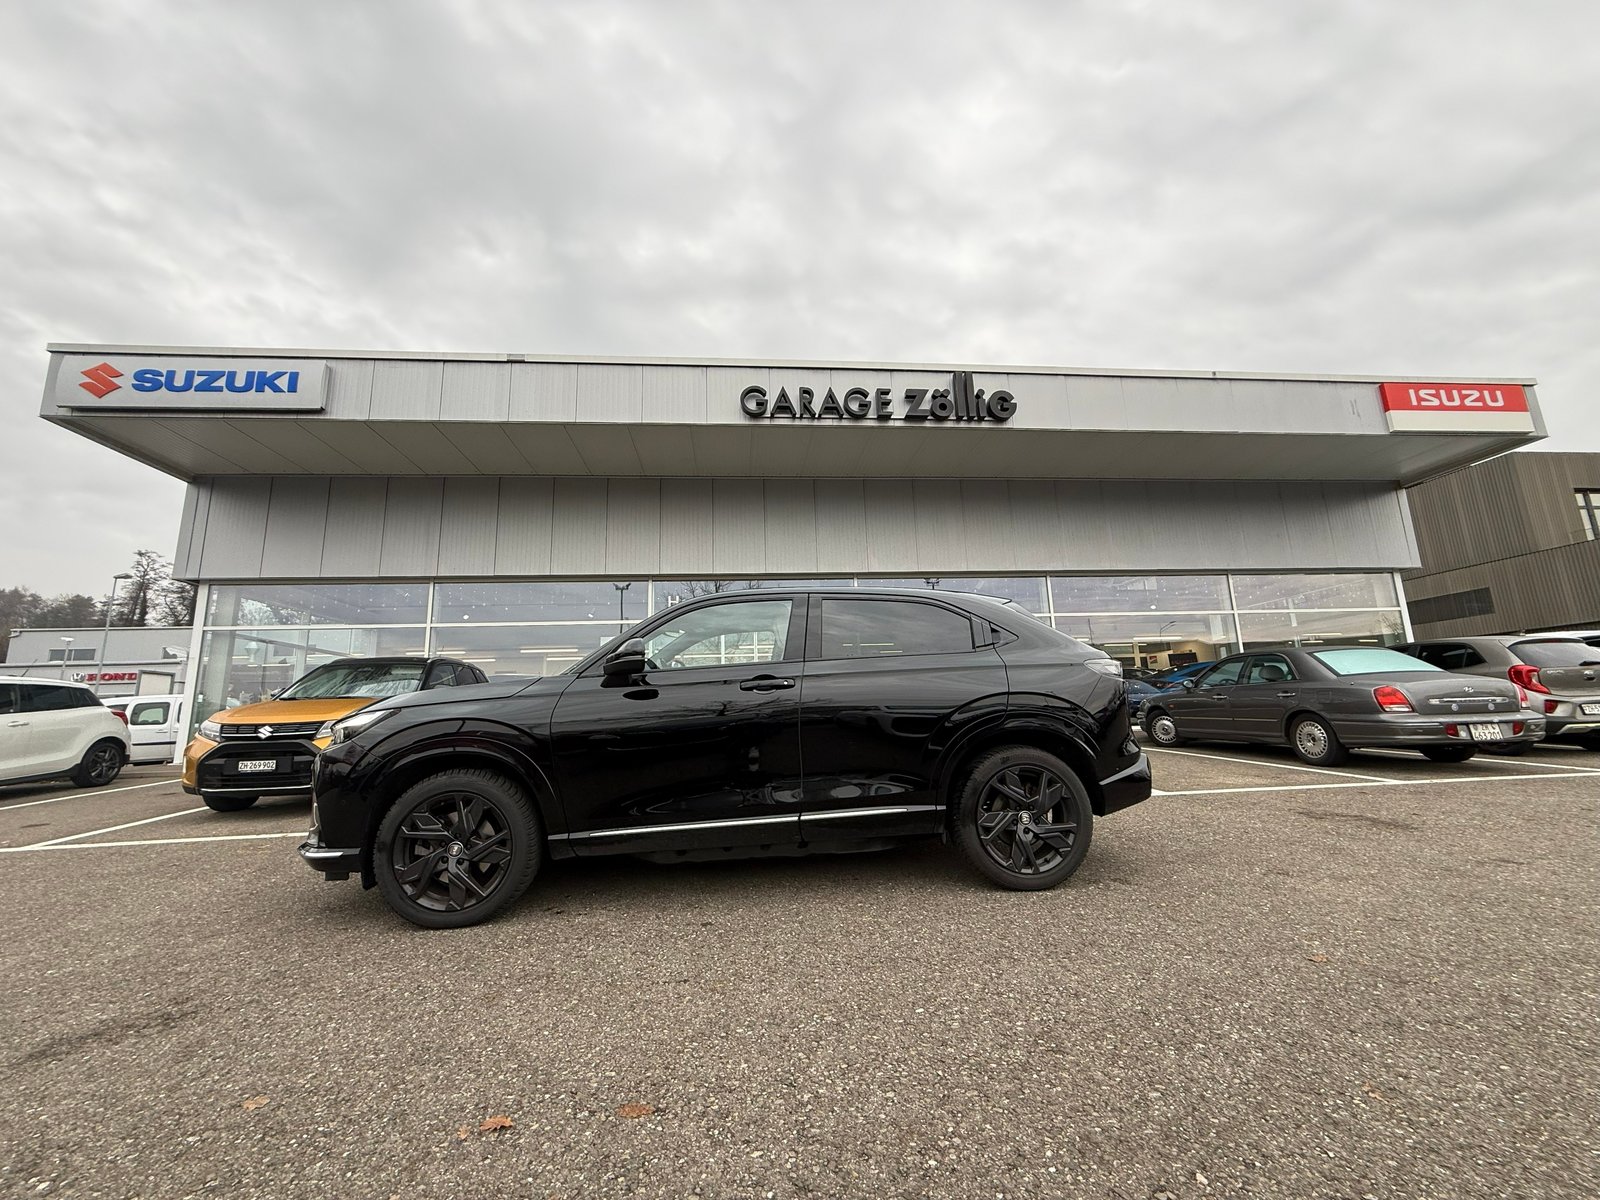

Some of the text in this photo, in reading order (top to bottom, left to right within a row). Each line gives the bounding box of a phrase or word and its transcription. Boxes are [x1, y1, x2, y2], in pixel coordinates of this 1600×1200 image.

[131, 368, 299, 393] SUZUKI
[740, 385, 894, 419] GARAGE
[1408, 388, 1505, 407] ISUZU
[86, 673, 137, 682] HOND
